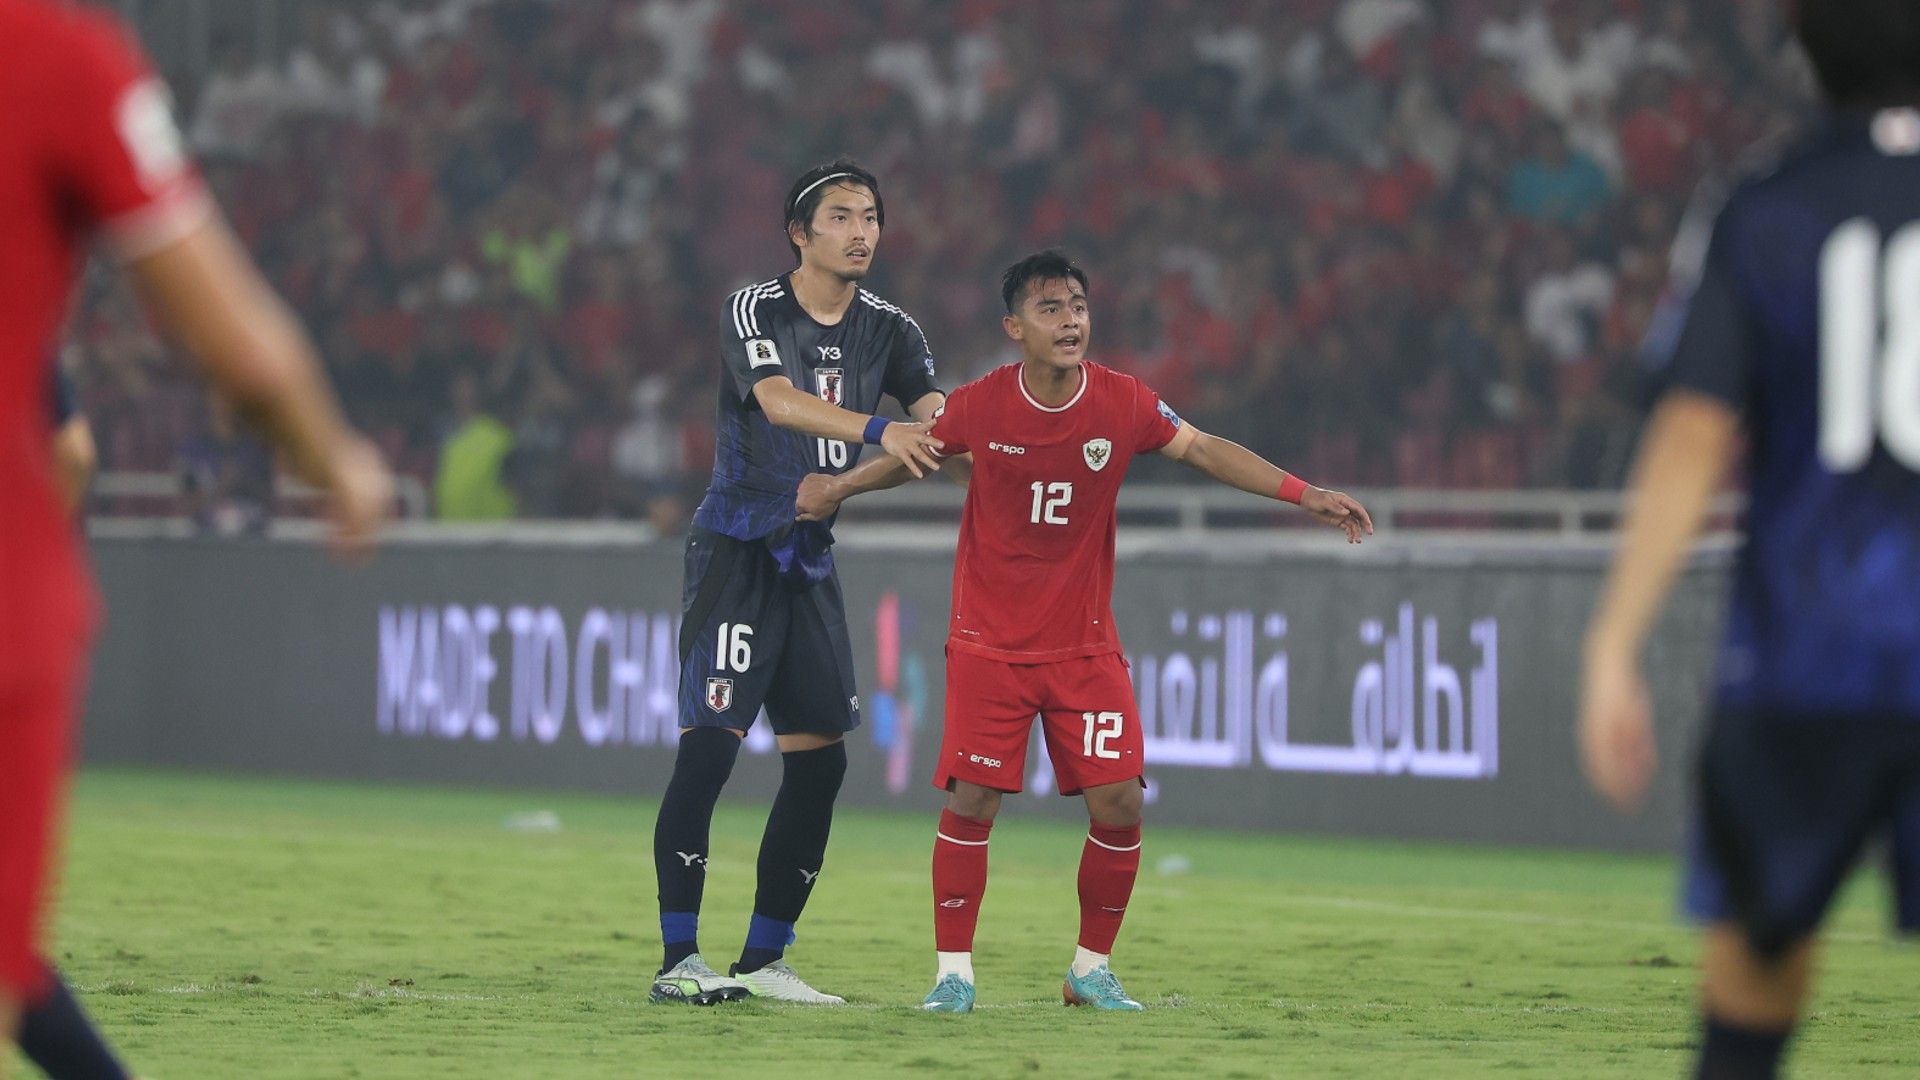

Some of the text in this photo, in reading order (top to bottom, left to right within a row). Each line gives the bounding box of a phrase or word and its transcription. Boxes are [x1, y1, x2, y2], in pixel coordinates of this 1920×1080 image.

[988, 441, 1025, 455] erspo
[1030, 481, 1073, 525] 12
[716, 622, 754, 673] 16
[376, 604, 499, 739] MADE
[507, 606, 568, 743] TO
[1082, 711, 1124, 759] 12
[970, 754, 1002, 768] erspo
